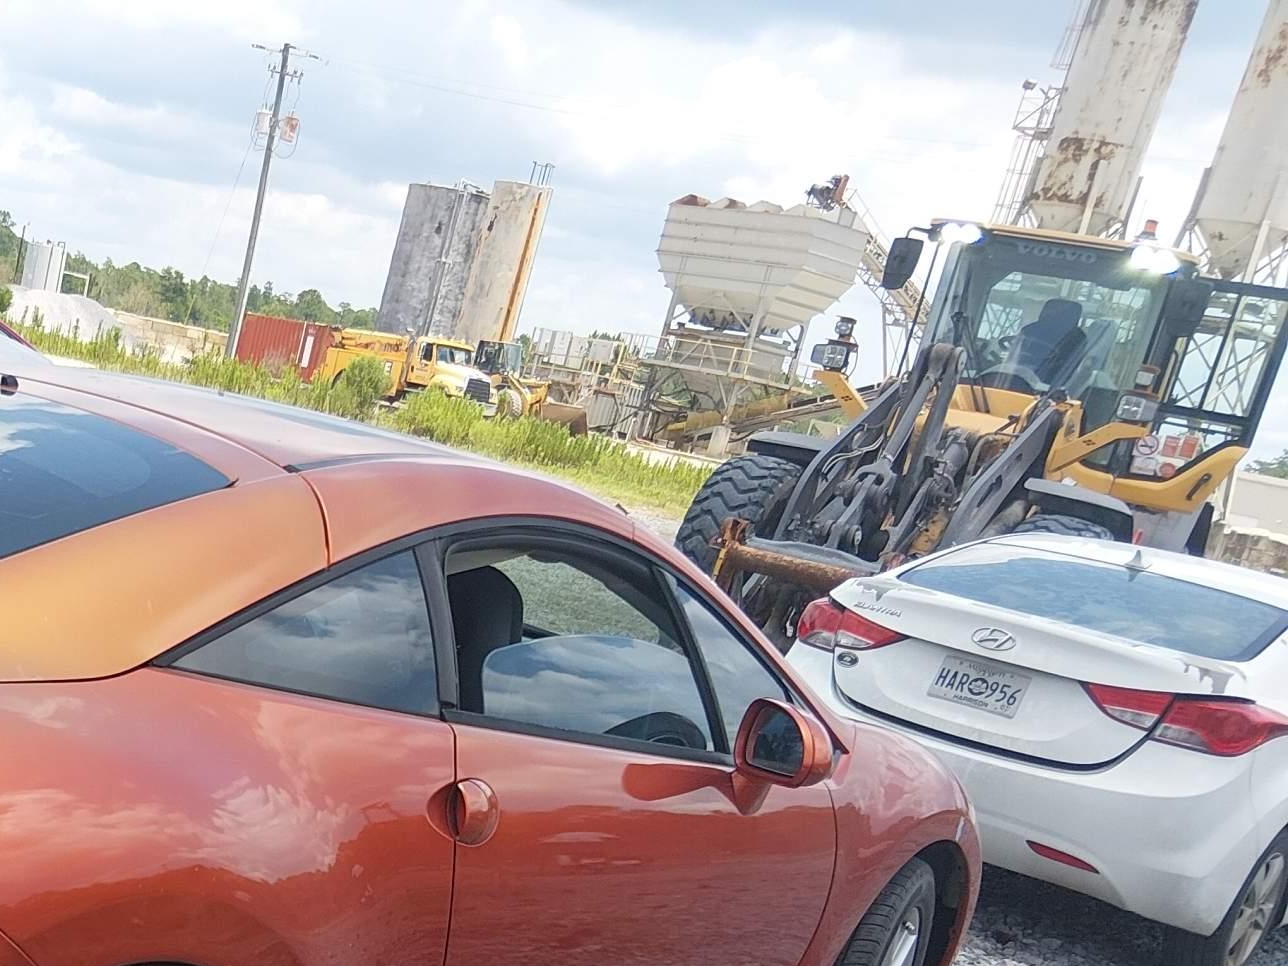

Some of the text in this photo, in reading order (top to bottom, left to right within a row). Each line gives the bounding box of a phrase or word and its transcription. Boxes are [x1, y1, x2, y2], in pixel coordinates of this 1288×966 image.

[1015, 241, 1097, 264] VOLVO
[935, 667, 970, 692] HAR
[985, 682, 1022, 706] 956
